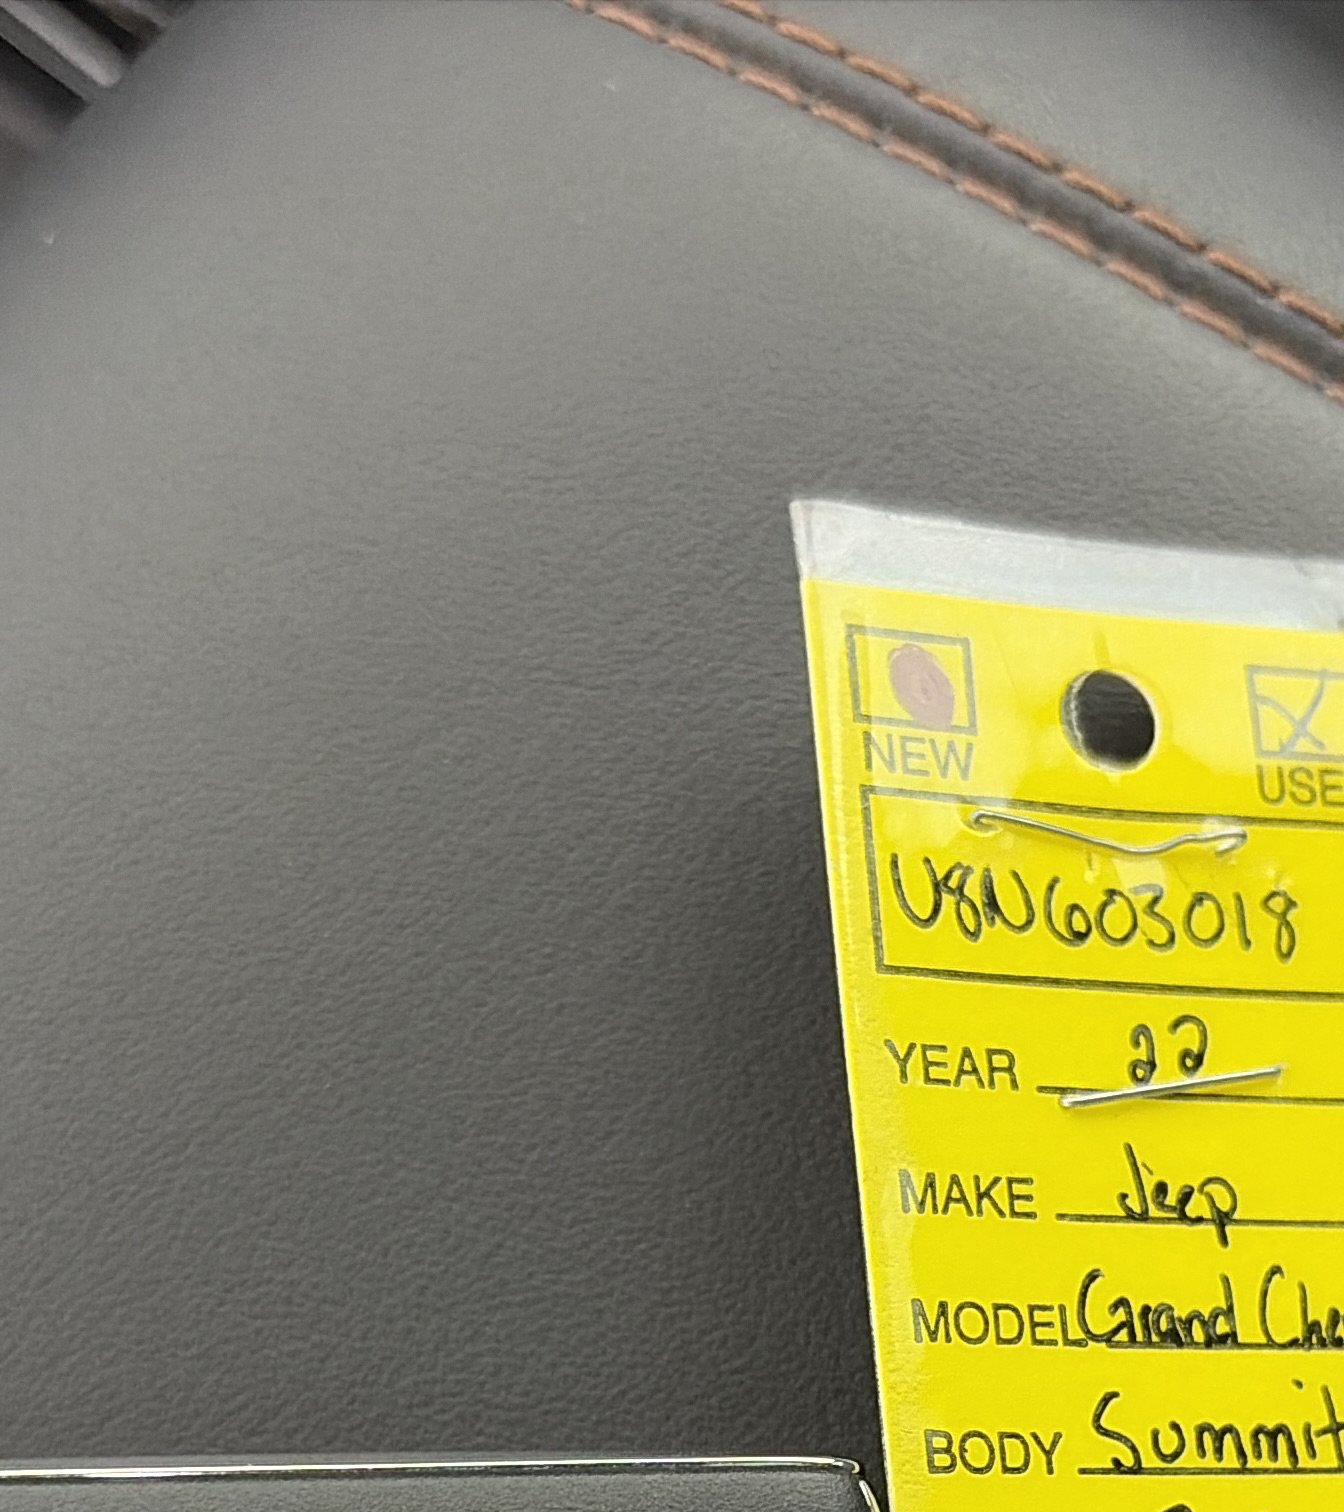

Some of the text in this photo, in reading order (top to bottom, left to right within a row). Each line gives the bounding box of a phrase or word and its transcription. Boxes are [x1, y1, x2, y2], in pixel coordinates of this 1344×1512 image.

[864, 734, 974, 782] NEW
[884, 1040, 1020, 1093] YEAR
[1127, 1016, 1208, 1085] 22
[898, 1169, 1039, 1220] MAKE
[1116, 1143, 1238, 1248] Jeep
[911, 1298, 1088, 1347] MODEL
[1077, 1267, 1239, 1348] Grand
[924, 1429, 1063, 1475] BODY
